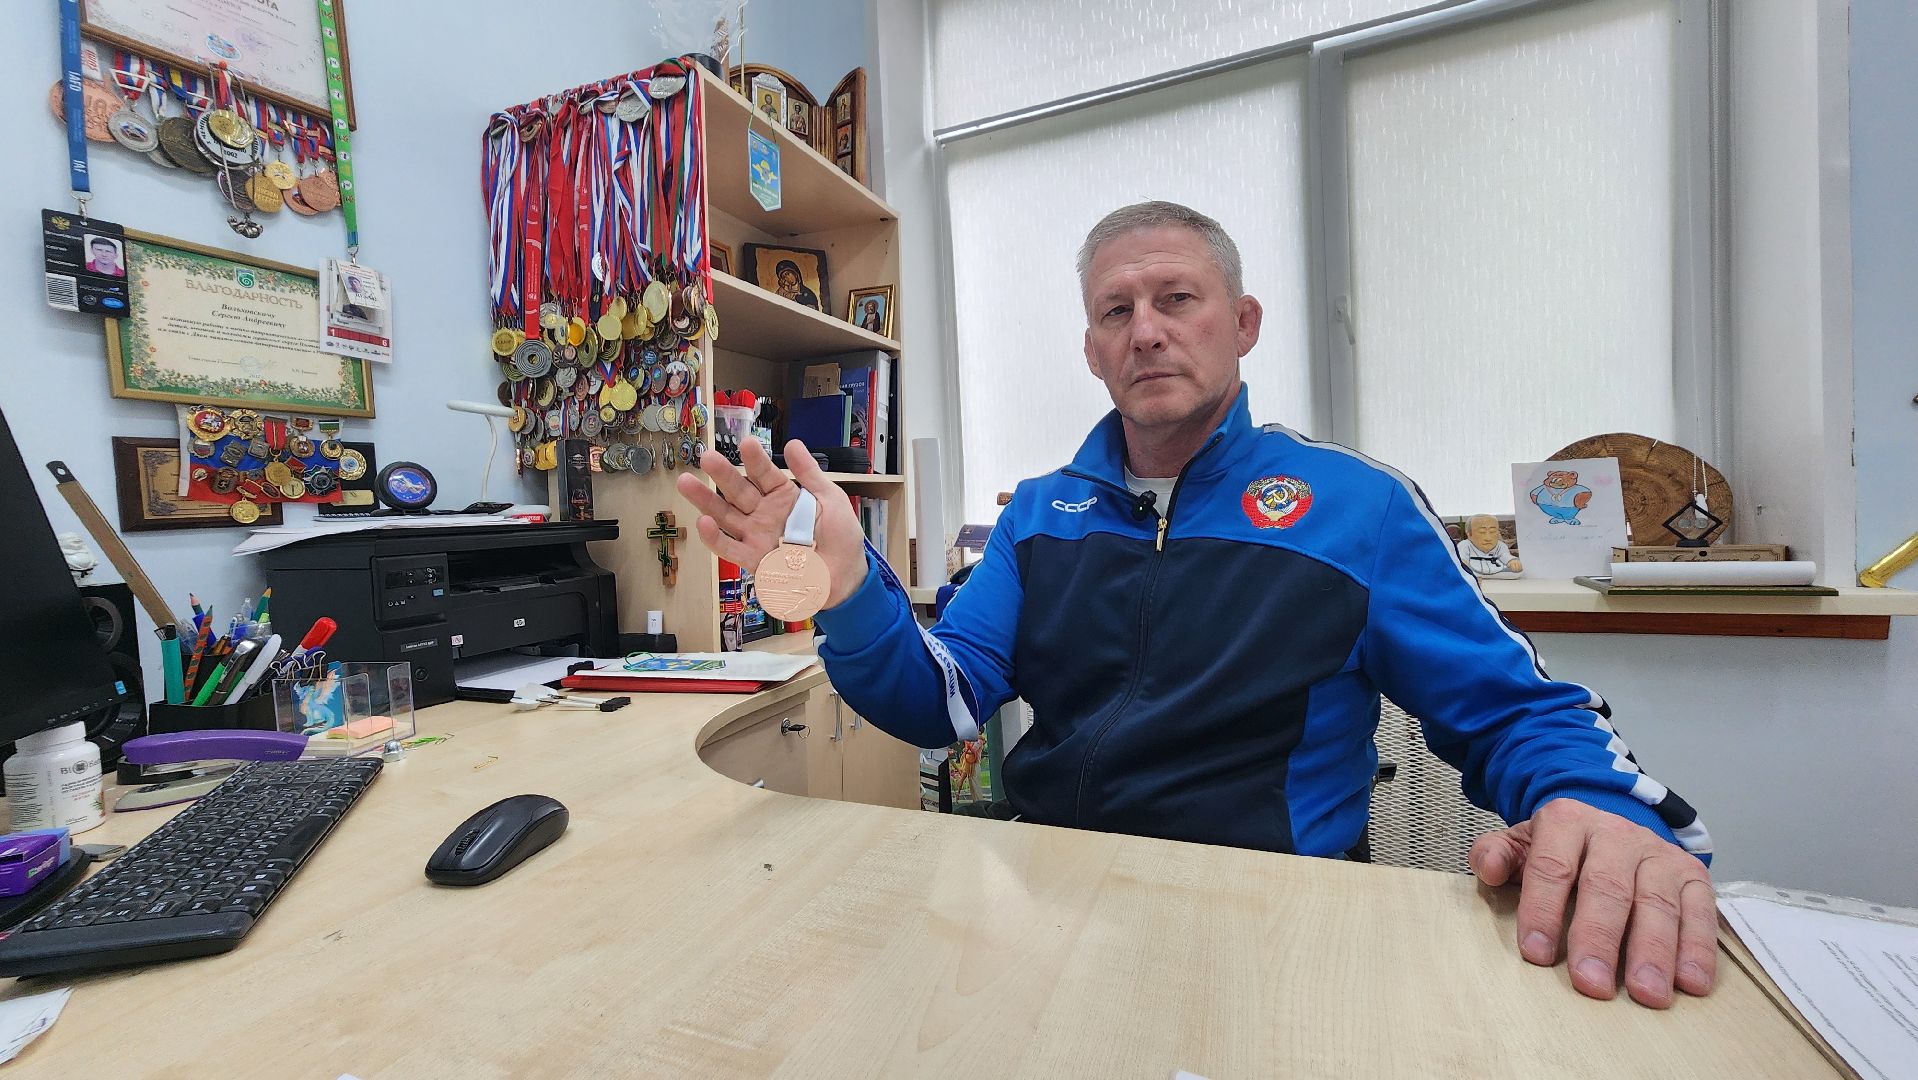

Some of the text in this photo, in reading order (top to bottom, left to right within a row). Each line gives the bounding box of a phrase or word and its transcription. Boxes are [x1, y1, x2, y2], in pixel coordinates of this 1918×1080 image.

[184, 278, 303, 309] БЛАГОДАРНОСТЬ
[329, 328, 335, 337] 1
[382, 339, 388, 347] 6
[1051, 496, 1098, 512] СССР
